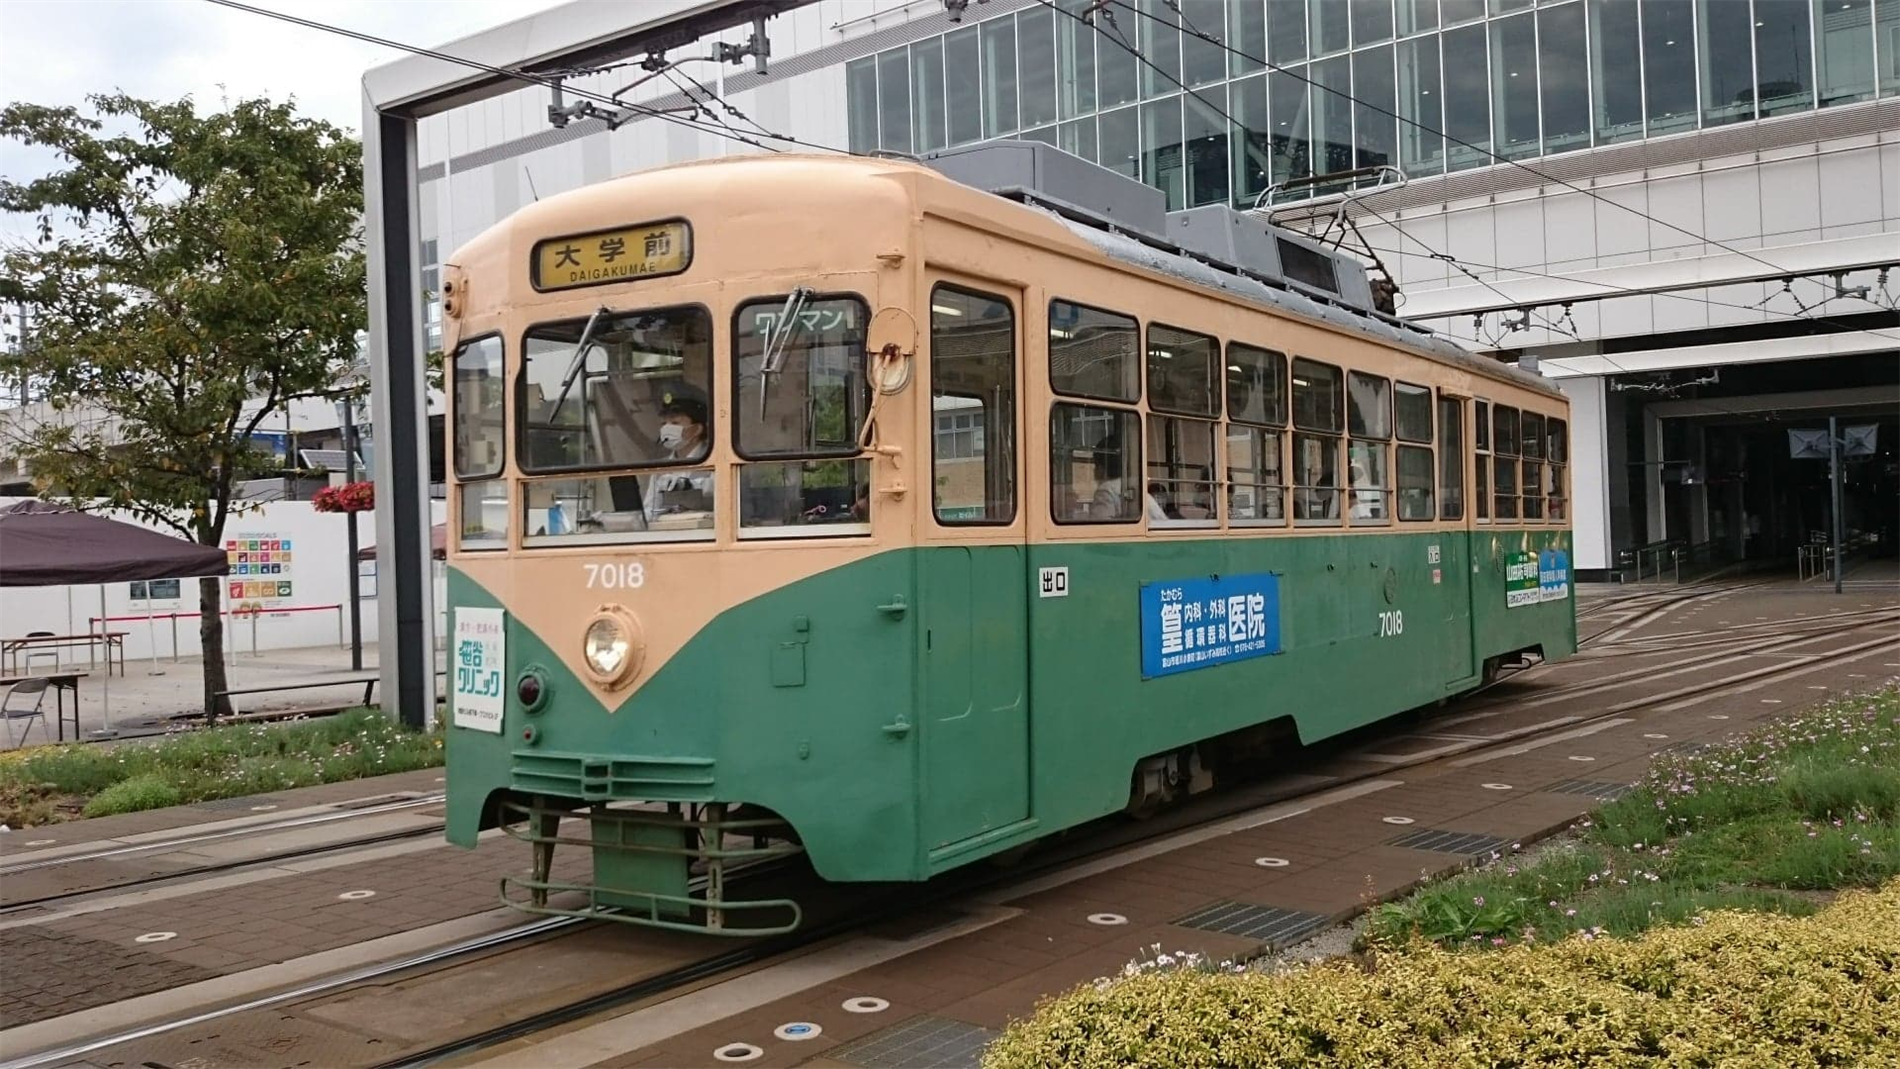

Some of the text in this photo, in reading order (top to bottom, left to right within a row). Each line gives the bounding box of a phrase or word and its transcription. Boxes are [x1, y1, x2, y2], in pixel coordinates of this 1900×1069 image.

[555, 231, 672, 269] 大学前
[570, 262, 657, 282] DAIGAKUMAE
[583, 562, 644, 589] 7018
[1043, 570, 1066, 592] 出口
[1160, 587, 1183, 602] たかむら
[1228, 592, 1266, 642] 医院
[1379, 609, 1403, 638] 7018
[459, 639, 483, 667] 笹谷
[458, 666, 500, 698] クリニック
